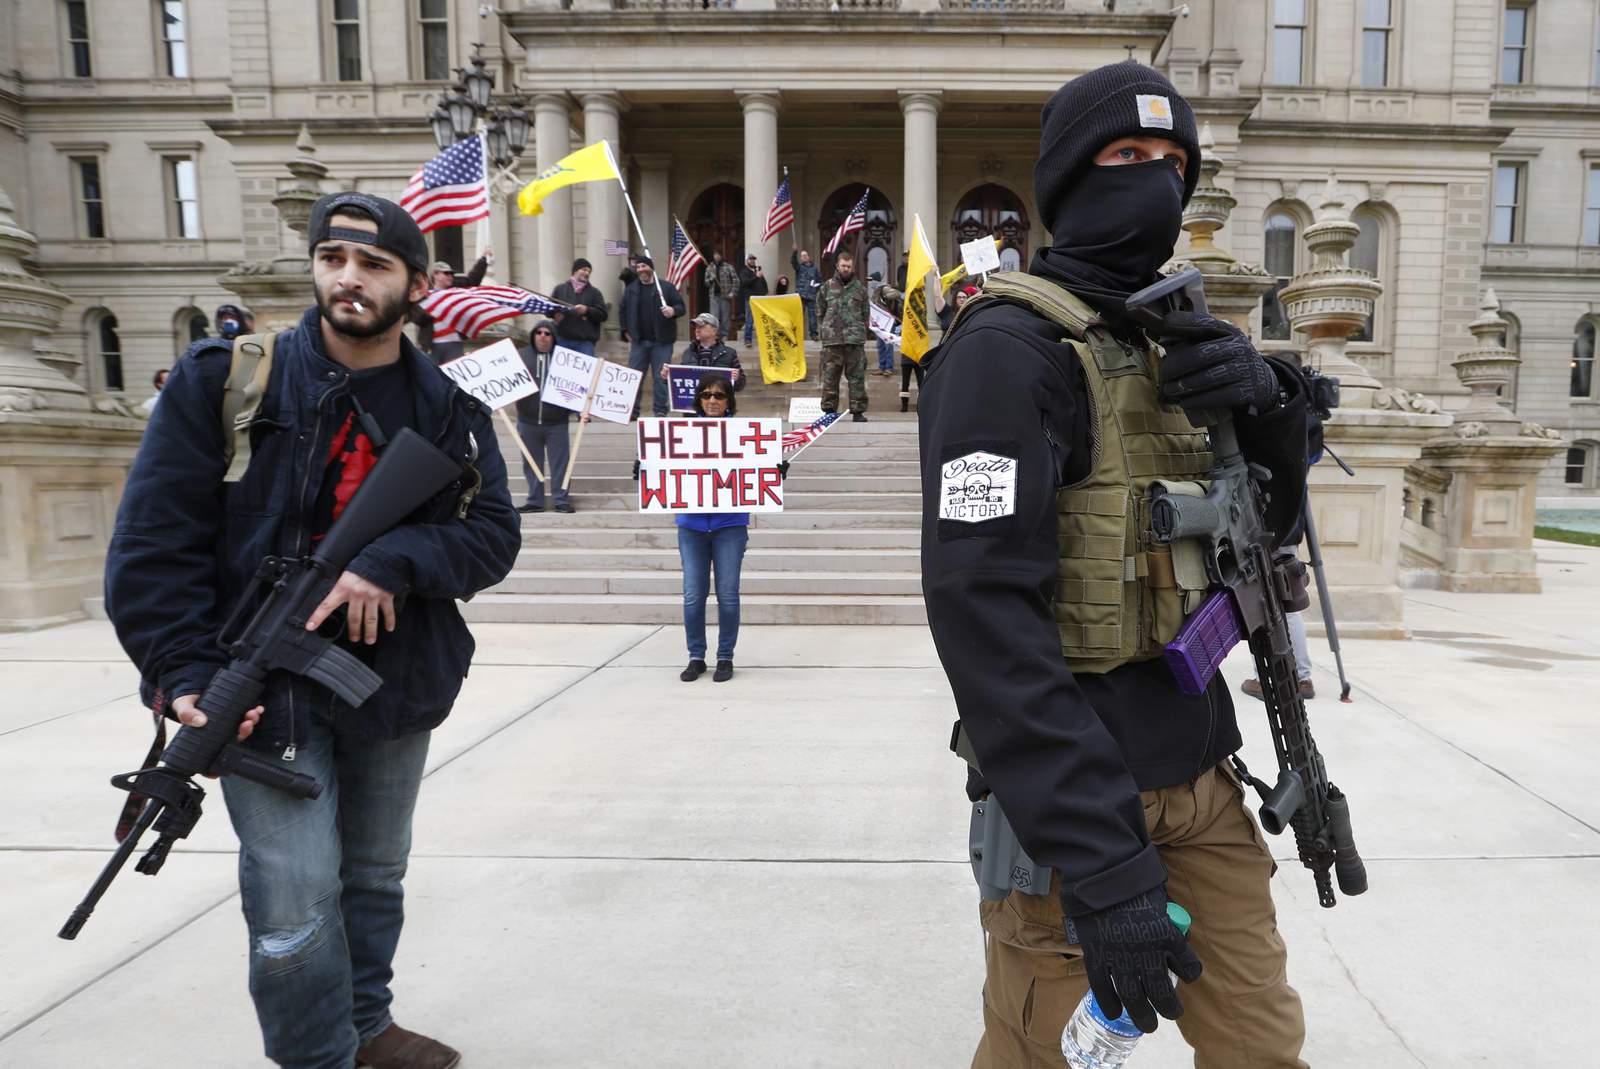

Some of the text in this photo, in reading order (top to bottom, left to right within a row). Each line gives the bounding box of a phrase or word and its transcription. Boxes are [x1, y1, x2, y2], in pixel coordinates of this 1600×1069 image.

[446, 355, 508, 382] ND THE
[555, 351, 592, 373] OPEN
[471, 369, 533, 402] CKDOWN
[548, 374, 589, 395] MICHIGAN
[605, 366, 638, 384] STOP
[608, 386, 624, 396] the
[638, 420, 744, 460] HEIL
[944, 458, 1013, 479] Death
[640, 467, 783, 509] WITMER
[945, 504, 1007, 517] VICTORY
